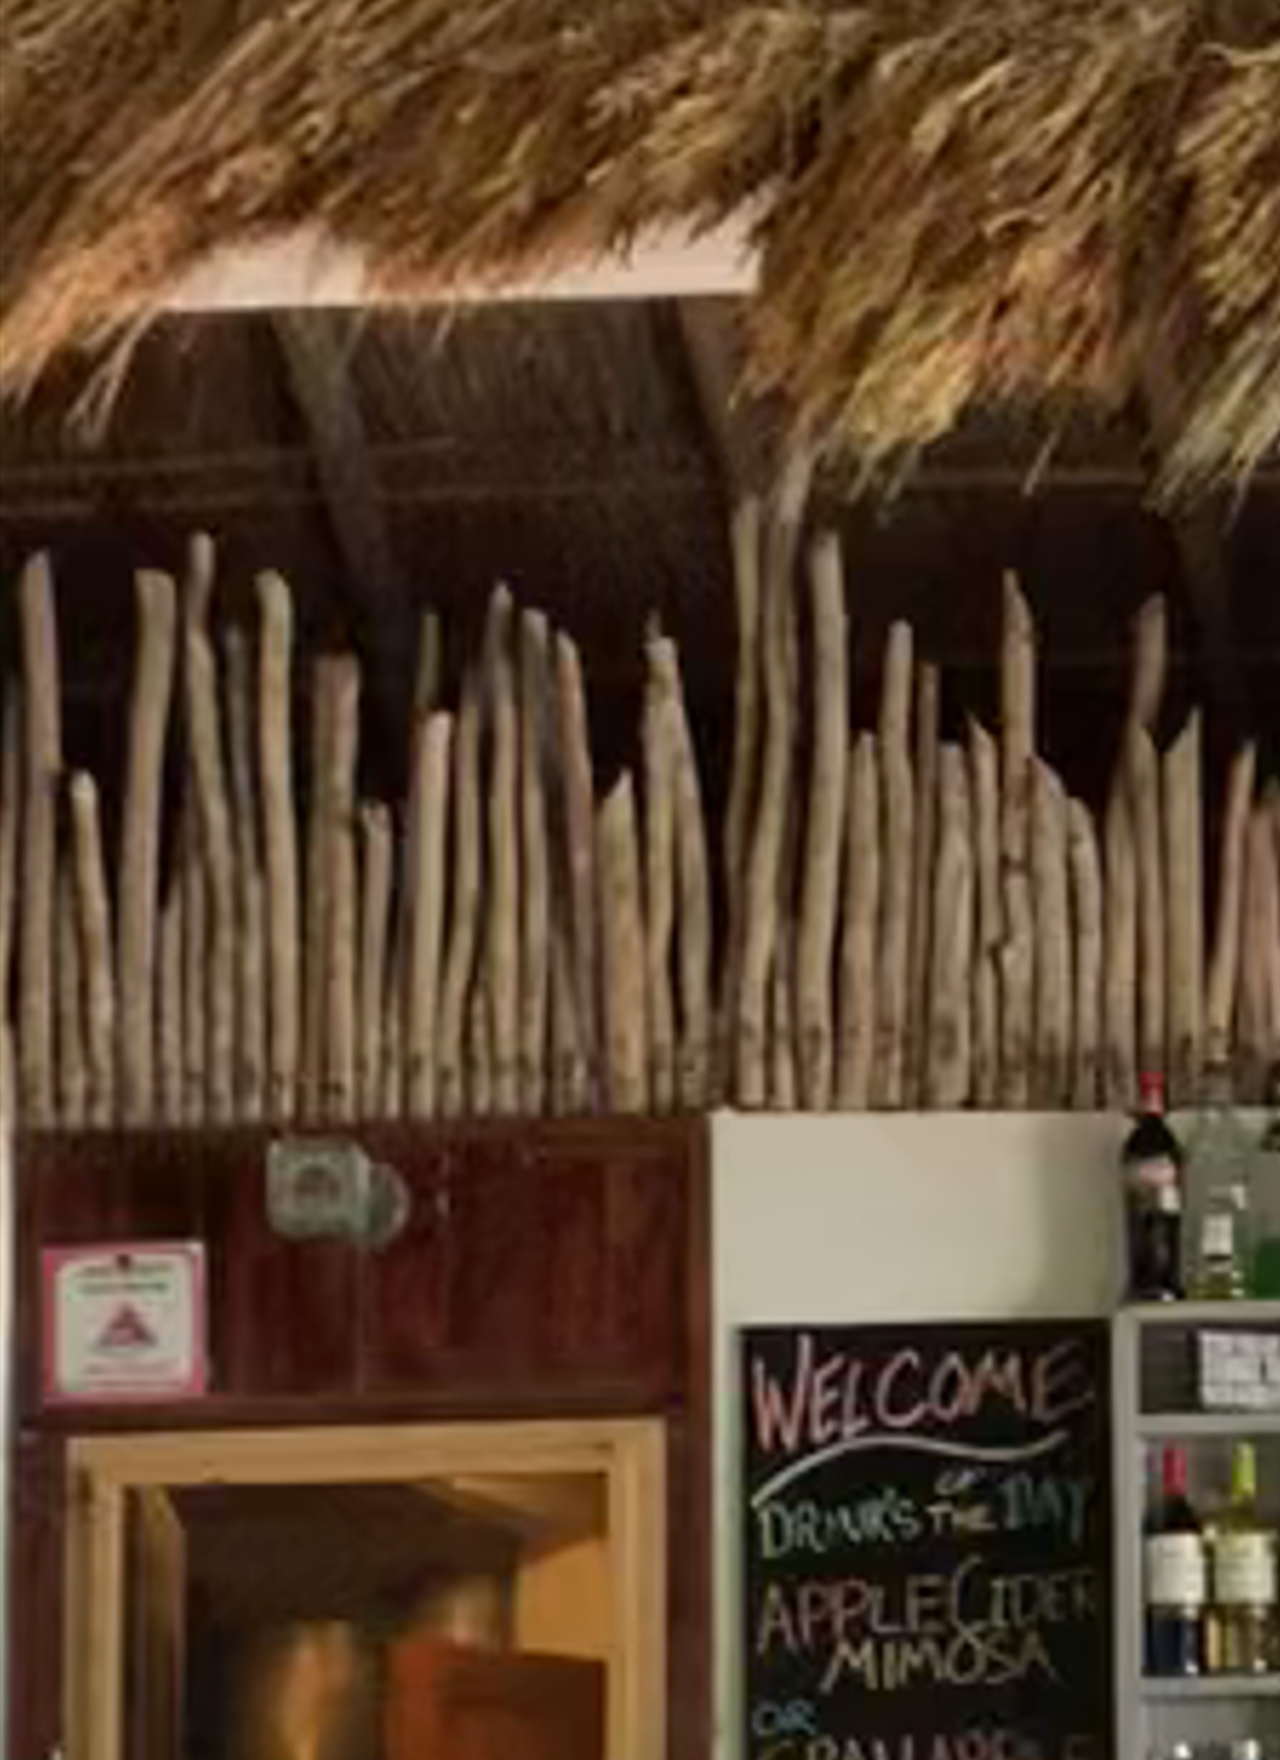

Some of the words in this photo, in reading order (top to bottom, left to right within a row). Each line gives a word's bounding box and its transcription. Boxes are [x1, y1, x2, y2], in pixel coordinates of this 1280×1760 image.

[751, 1333, 1096, 1453] WELCOME
[1000, 1476, 1089, 1543] DAY
[755, 1575, 950, 1659] APPLE
[950, 1554, 1098, 1638] CIDER
[817, 1626, 1066, 1695] MIMOSA
[752, 1698, 819, 1738] OR
